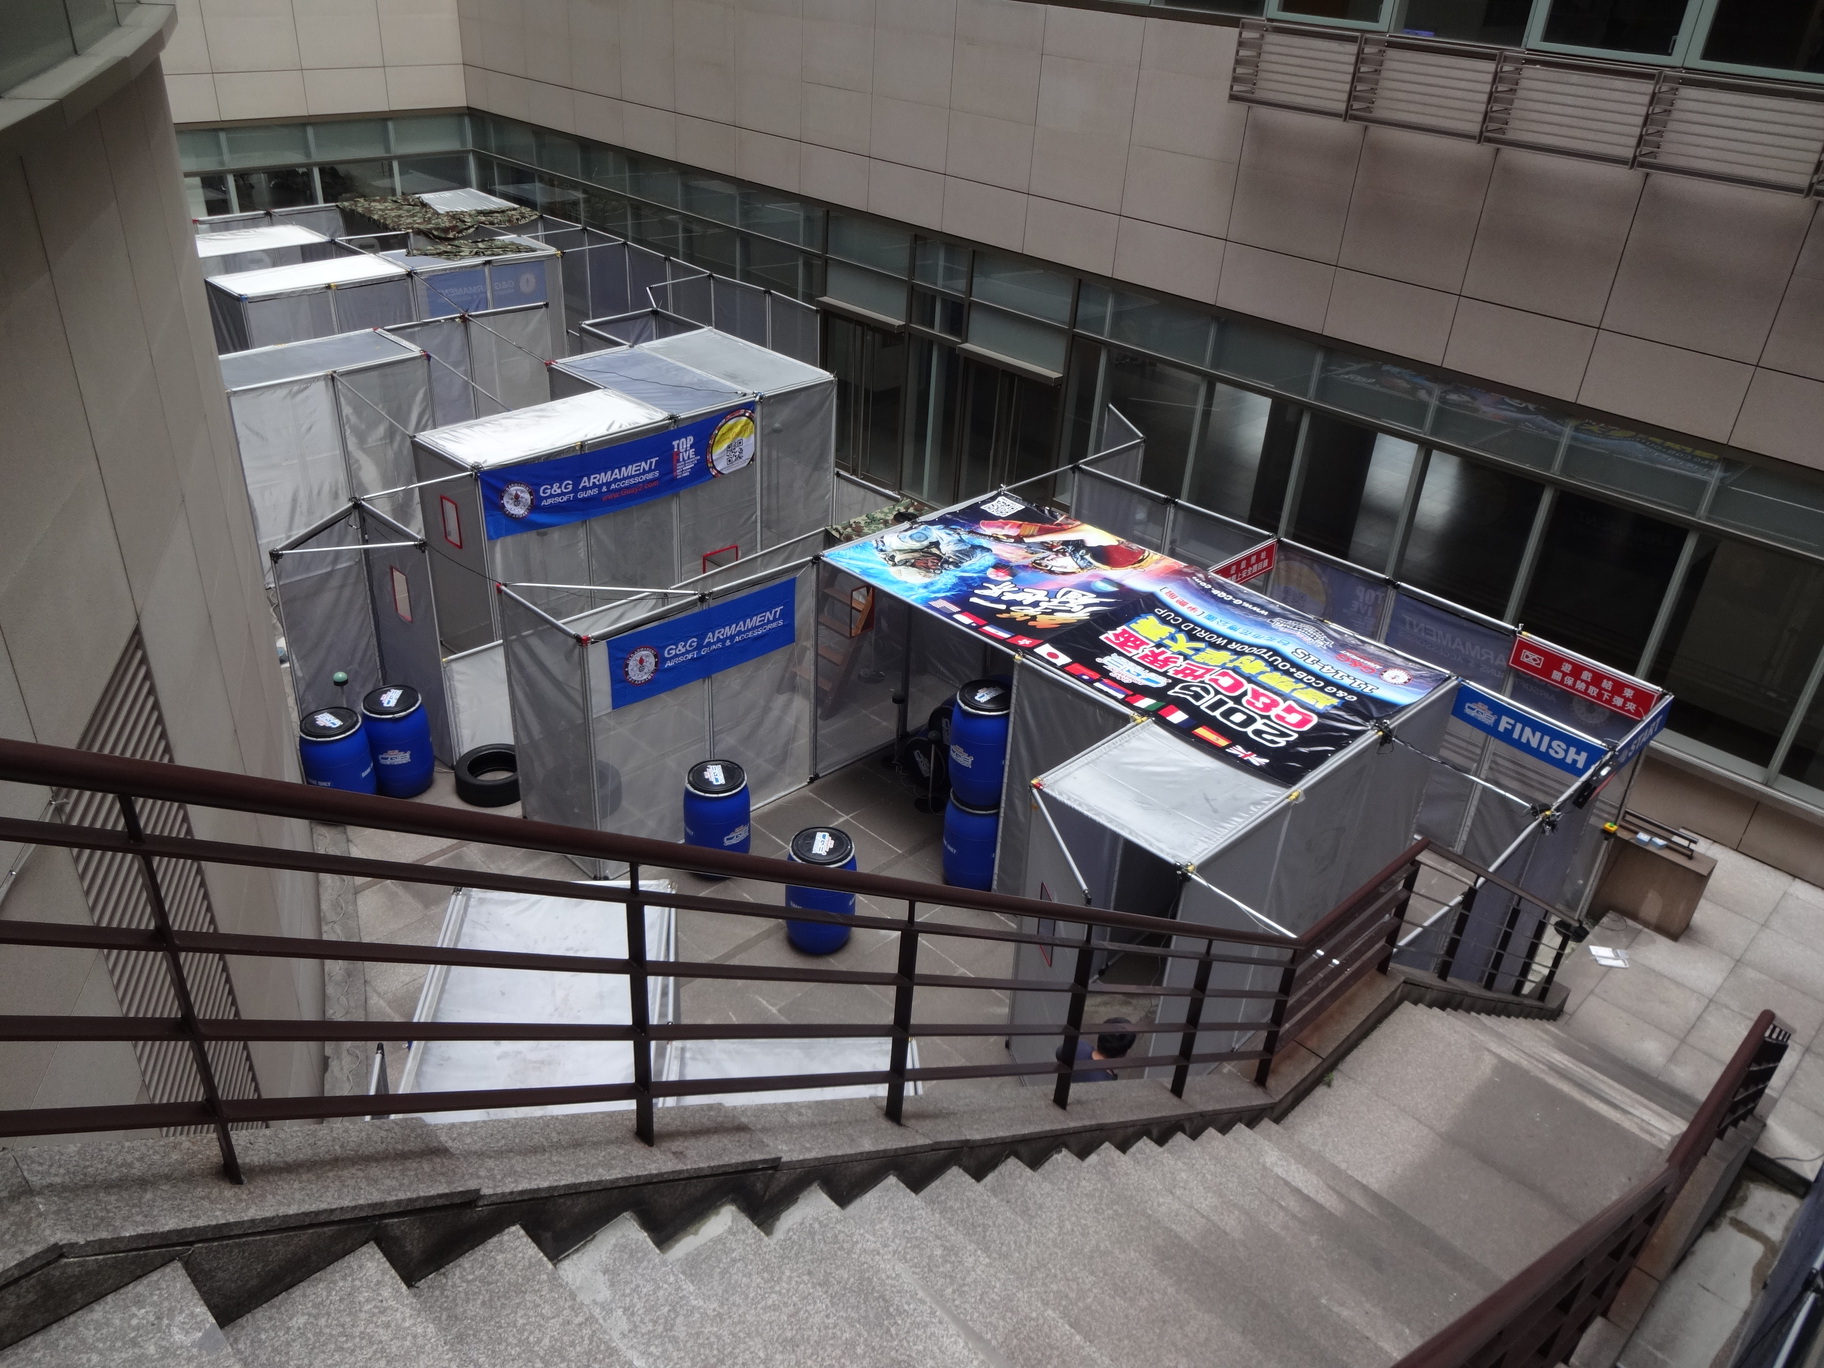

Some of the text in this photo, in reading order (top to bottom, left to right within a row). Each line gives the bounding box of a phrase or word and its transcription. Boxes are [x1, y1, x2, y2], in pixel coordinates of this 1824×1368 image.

[672, 436, 694, 453] TOP
[672, 449, 695, 466] FIVE
[540, 480, 573, 497] G&G
[578, 457, 659, 489] ARMAMENT
[541, 470, 660, 507] AIRSOFT GUNS & ACCESSORIES
[664, 606, 784, 658] G&G ARMAMENT
[1152, 606, 1183, 625] CUP
[1178, 621, 1228, 645] WORLD
[665, 650, 698, 668] AIRSOFT
[700, 642, 723, 656] GUNS
[733, 619, 784, 643] ACCESSORIES
[1332, 652, 1379, 675] G&G
[1226, 641, 1327, 688] CQB+OUTDOOR
[1288, 646, 1379, 695] 11.14-15
[1560, 661, 1635, 699] 遊戲結束
[1322, 684, 1358, 702] G&G
[1551, 669, 1637, 714] 關保險取下彈夾
[1165, 683, 1300, 747] 2015
[1497, 715, 1588, 769] FINISH
[1628, 714, 1663, 757] START
